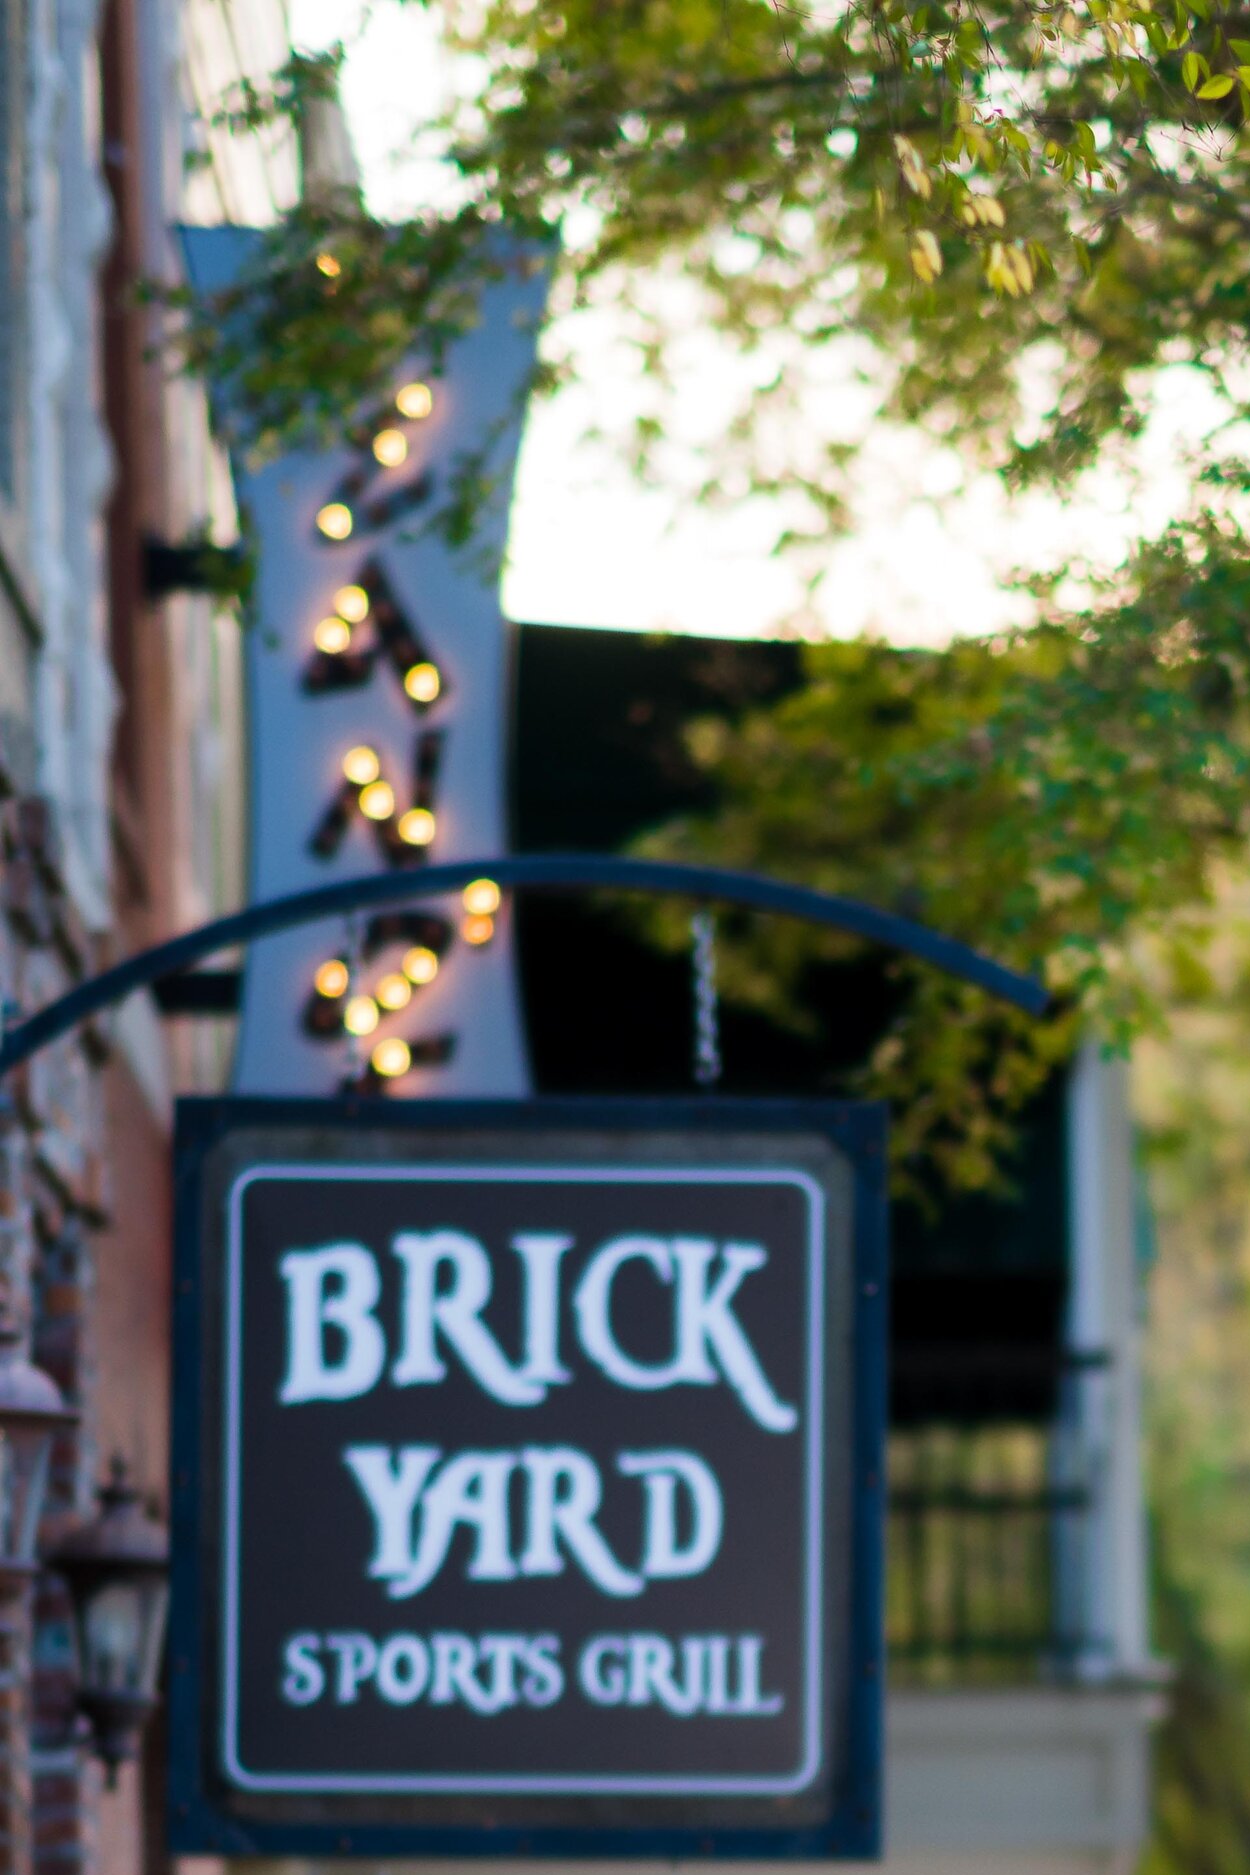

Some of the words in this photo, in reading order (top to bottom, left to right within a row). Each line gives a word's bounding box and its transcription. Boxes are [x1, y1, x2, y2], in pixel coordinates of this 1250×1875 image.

[281, 1231, 798, 1433] BRICK
[344, 1444, 724, 1599] YARD
[283, 1633, 564, 1714] SPORTS
[579, 1634, 784, 1714] GRILL
